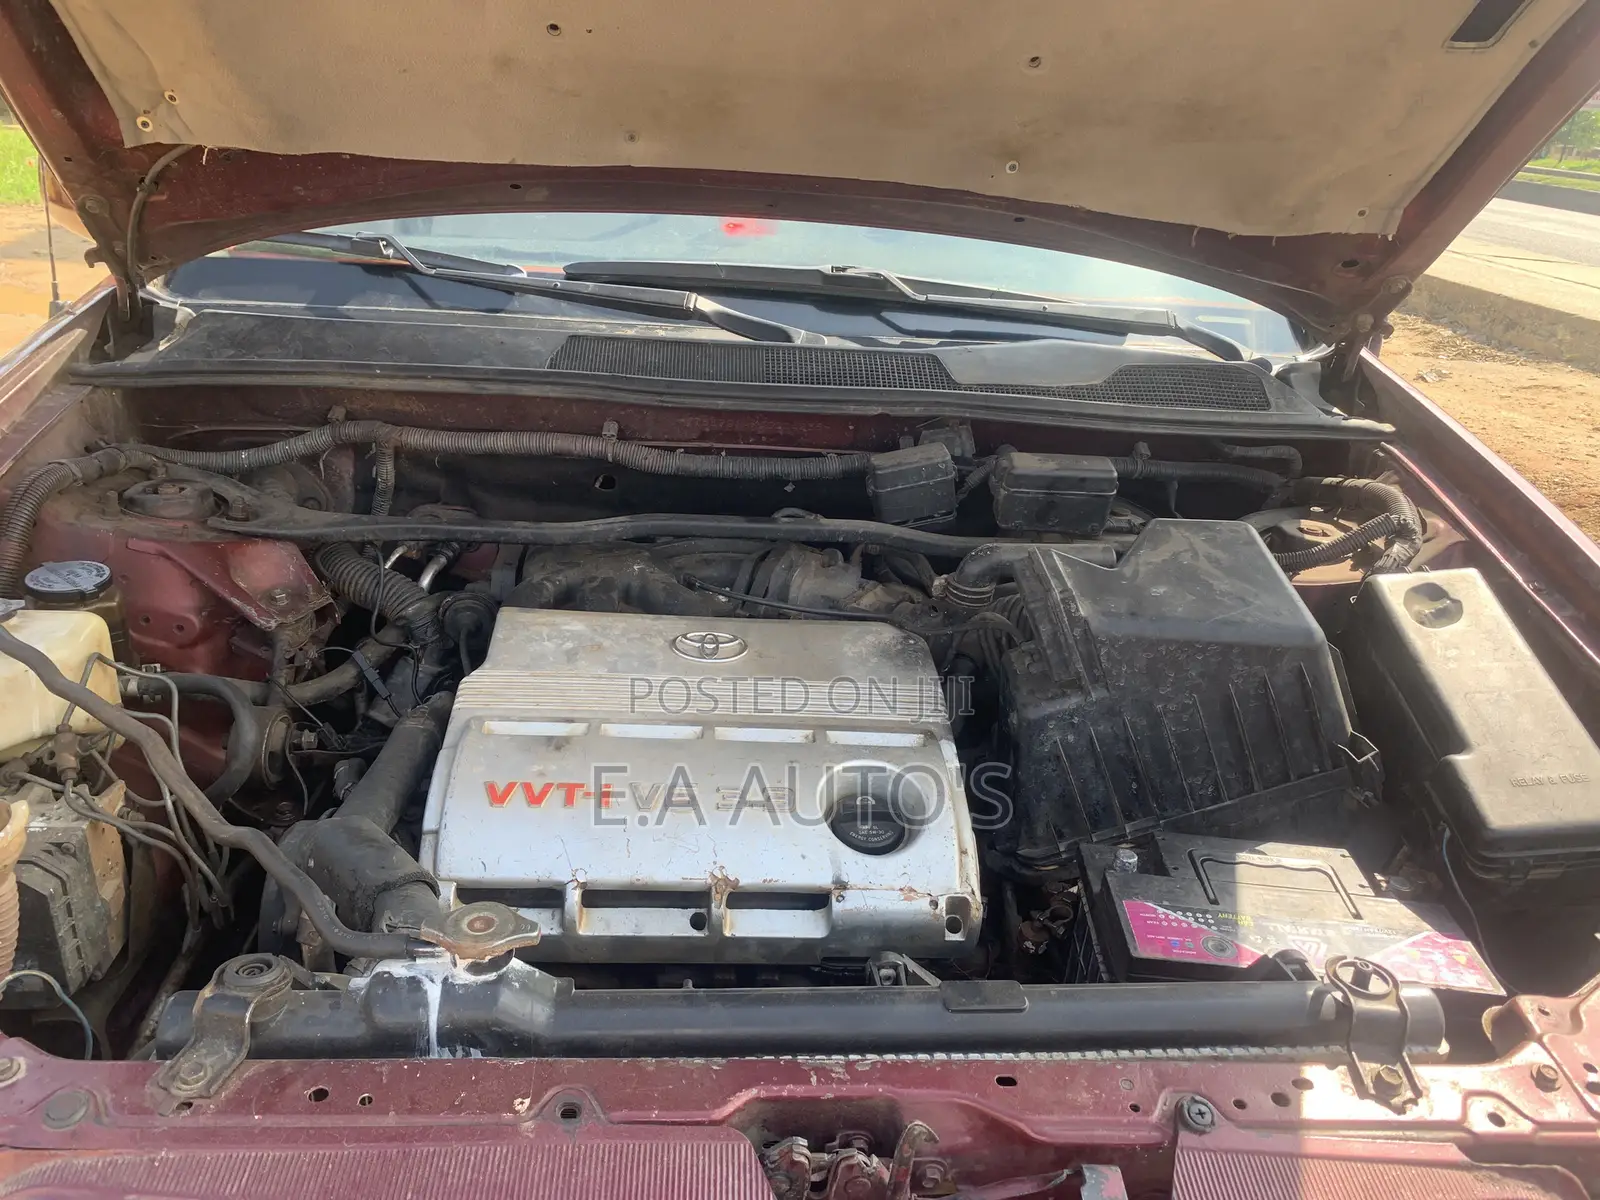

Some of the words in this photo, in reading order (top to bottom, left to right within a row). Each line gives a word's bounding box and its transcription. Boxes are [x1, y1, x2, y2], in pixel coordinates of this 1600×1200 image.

[1509, 775, 1544, 787] RELAY
[1559, 772, 1590, 784] FUSE
[1217, 912, 1252, 921] BATTERY
